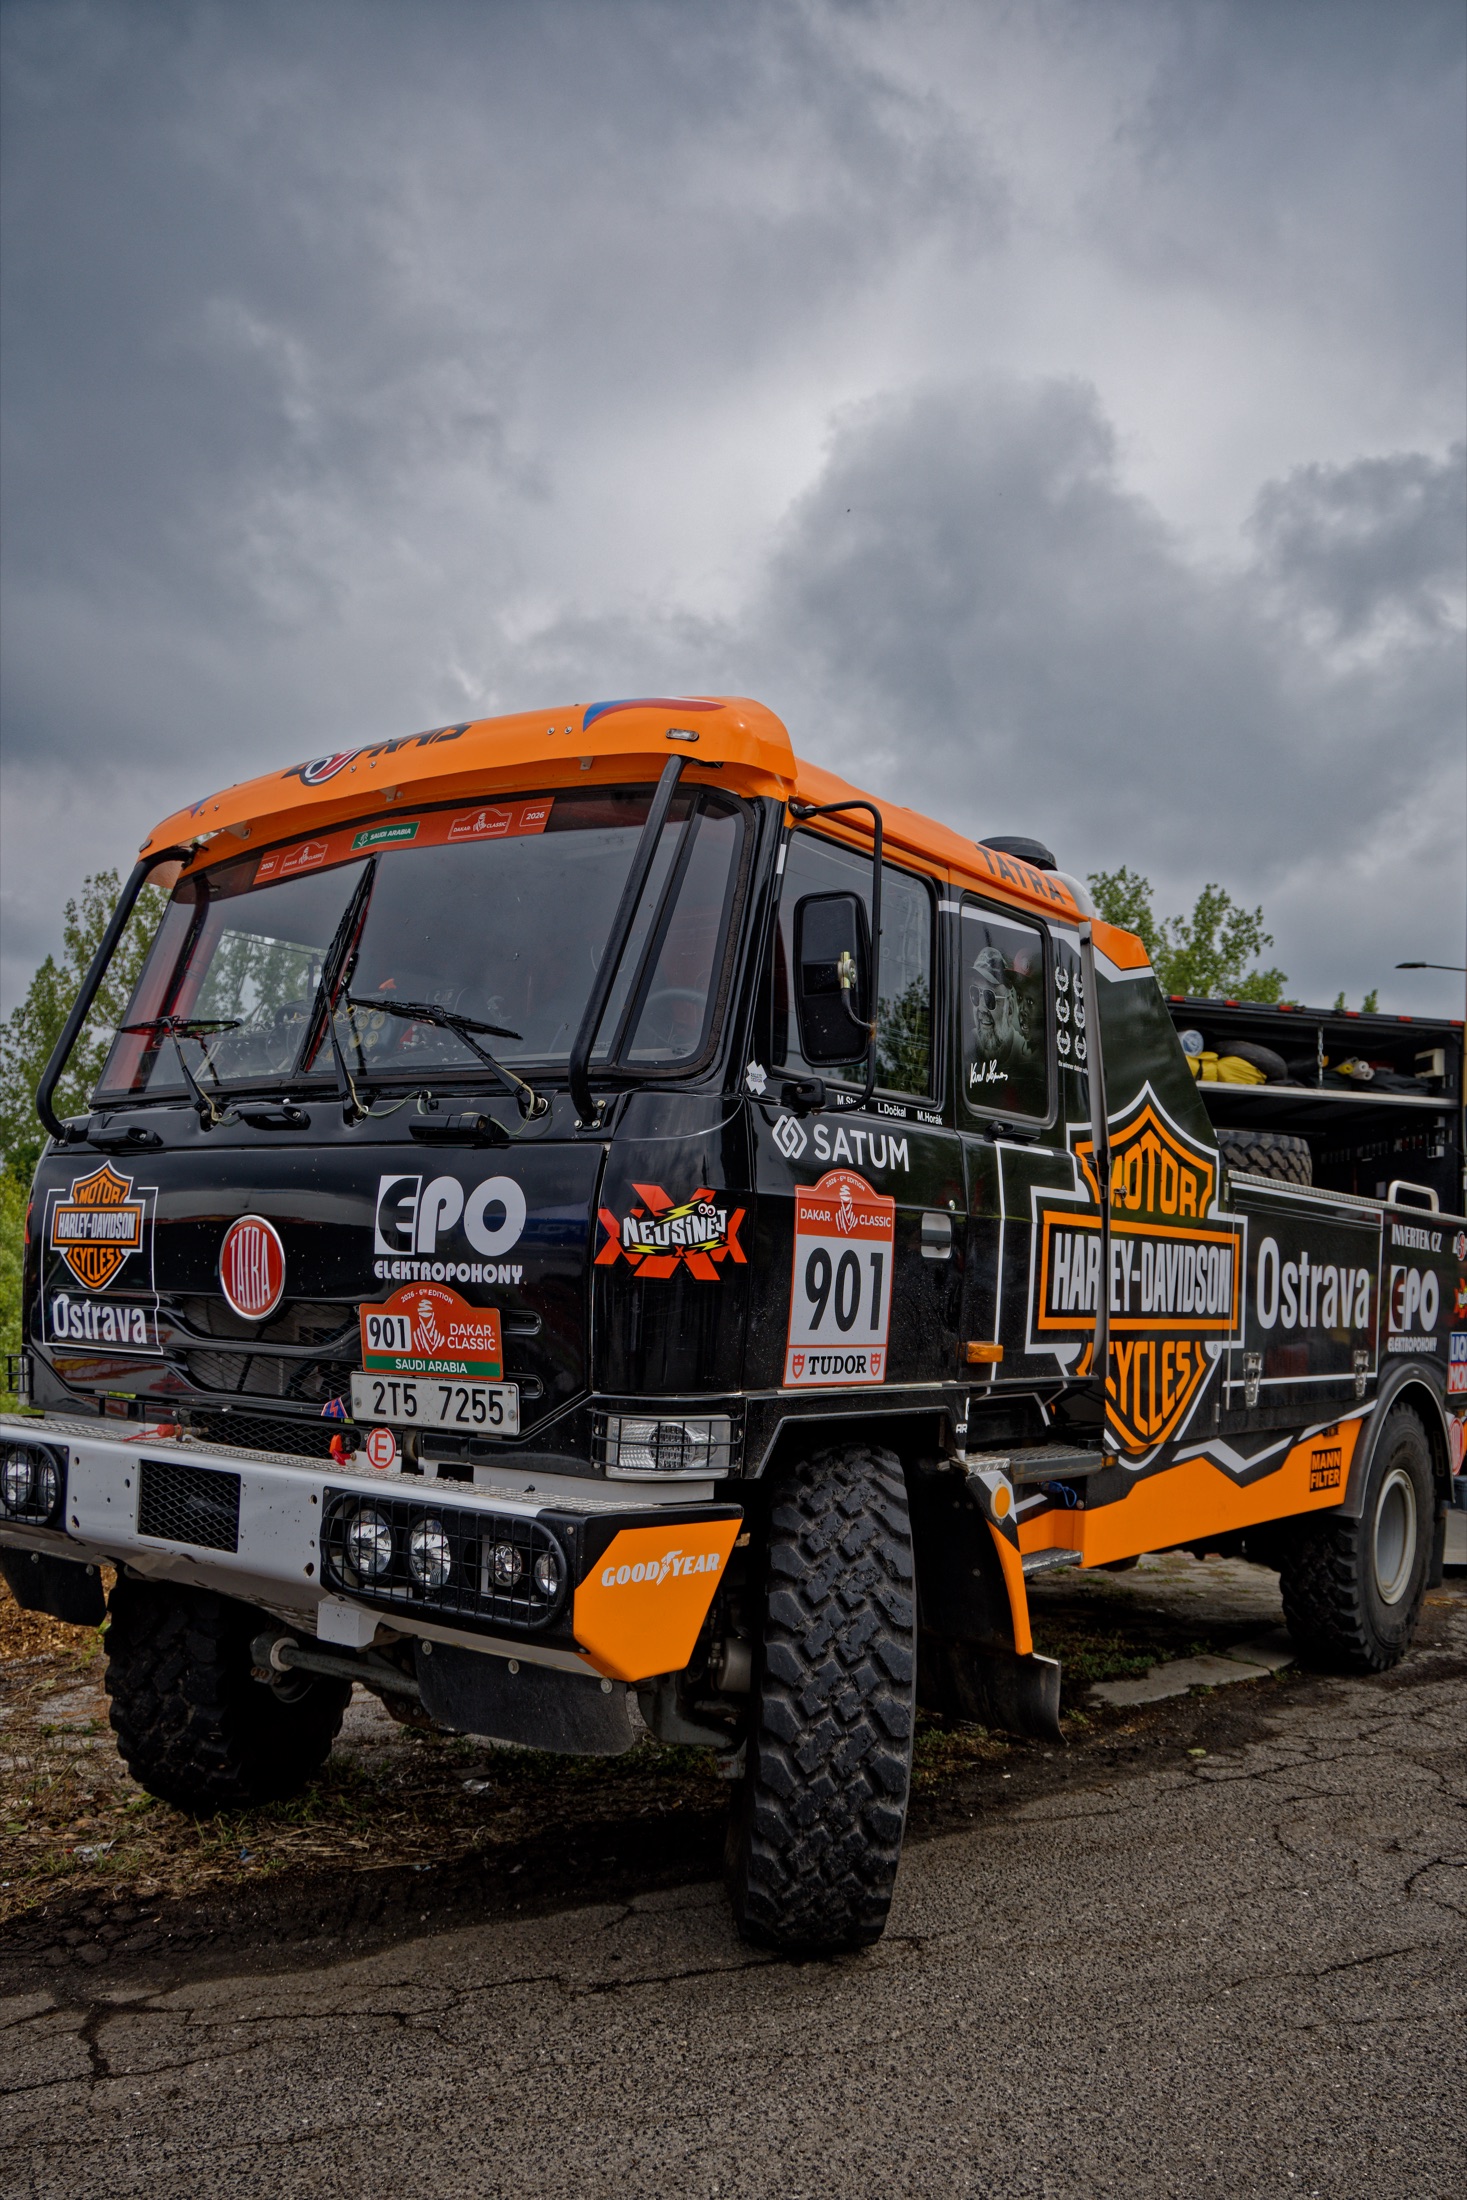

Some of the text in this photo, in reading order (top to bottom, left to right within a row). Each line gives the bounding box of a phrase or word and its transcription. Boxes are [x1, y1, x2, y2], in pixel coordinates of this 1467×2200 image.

[486, 821, 507, 829] CLASSIC
[526, 811, 545, 820] 2026
[370, 828, 411, 840] SAUDI ARABIA
[975, 844, 1066, 905] TATRA
[813, 1124, 910, 1172] SATUM
[79, 1175, 121, 1204] MOTOR
[57, 1212, 136, 1239] HARLEY-DAVIDSON
[374, 1175, 527, 1257] EPO
[800, 1207, 891, 1228] DAKAR CLASSIC
[1391, 1223, 1430, 1251] INVERTEK
[1431, 1231, 1442, 1253] CZ
[73, 1247, 115, 1281] CYCLES
[230, 1226, 270, 1310] TATRA
[373, 1260, 523, 1284] ELEKTROPOHONY
[1052, 1232, 1231, 1314] HAREY-DAVIDSON
[401, 1291, 415, 1303] 2026
[428, 1289, 453, 1304] EDITION
[805, 1247, 884, 1332] 901
[1257, 1237, 1370, 1329] Ostrava
[1388, 1264, 1439, 1332] EPO
[53, 1293, 148, 1344] Ostrava
[369, 1316, 406, 1349] 901
[450, 1323, 491, 1337] DAKAR
[447, 1336, 496, 1351] CLASSIC
[1452, 1335, 1467, 1362] LIQ
[395, 1359, 468, 1374] SAUDI ARABIA
[808, 1355, 867, 1375] TUDOR
[372, 1381, 504, 1425] 2T5 7255
[374, 1433, 388, 1462] E
[1312, 1450, 1340, 1471] MANN
[1310, 1468, 1340, 1489] FILTER
